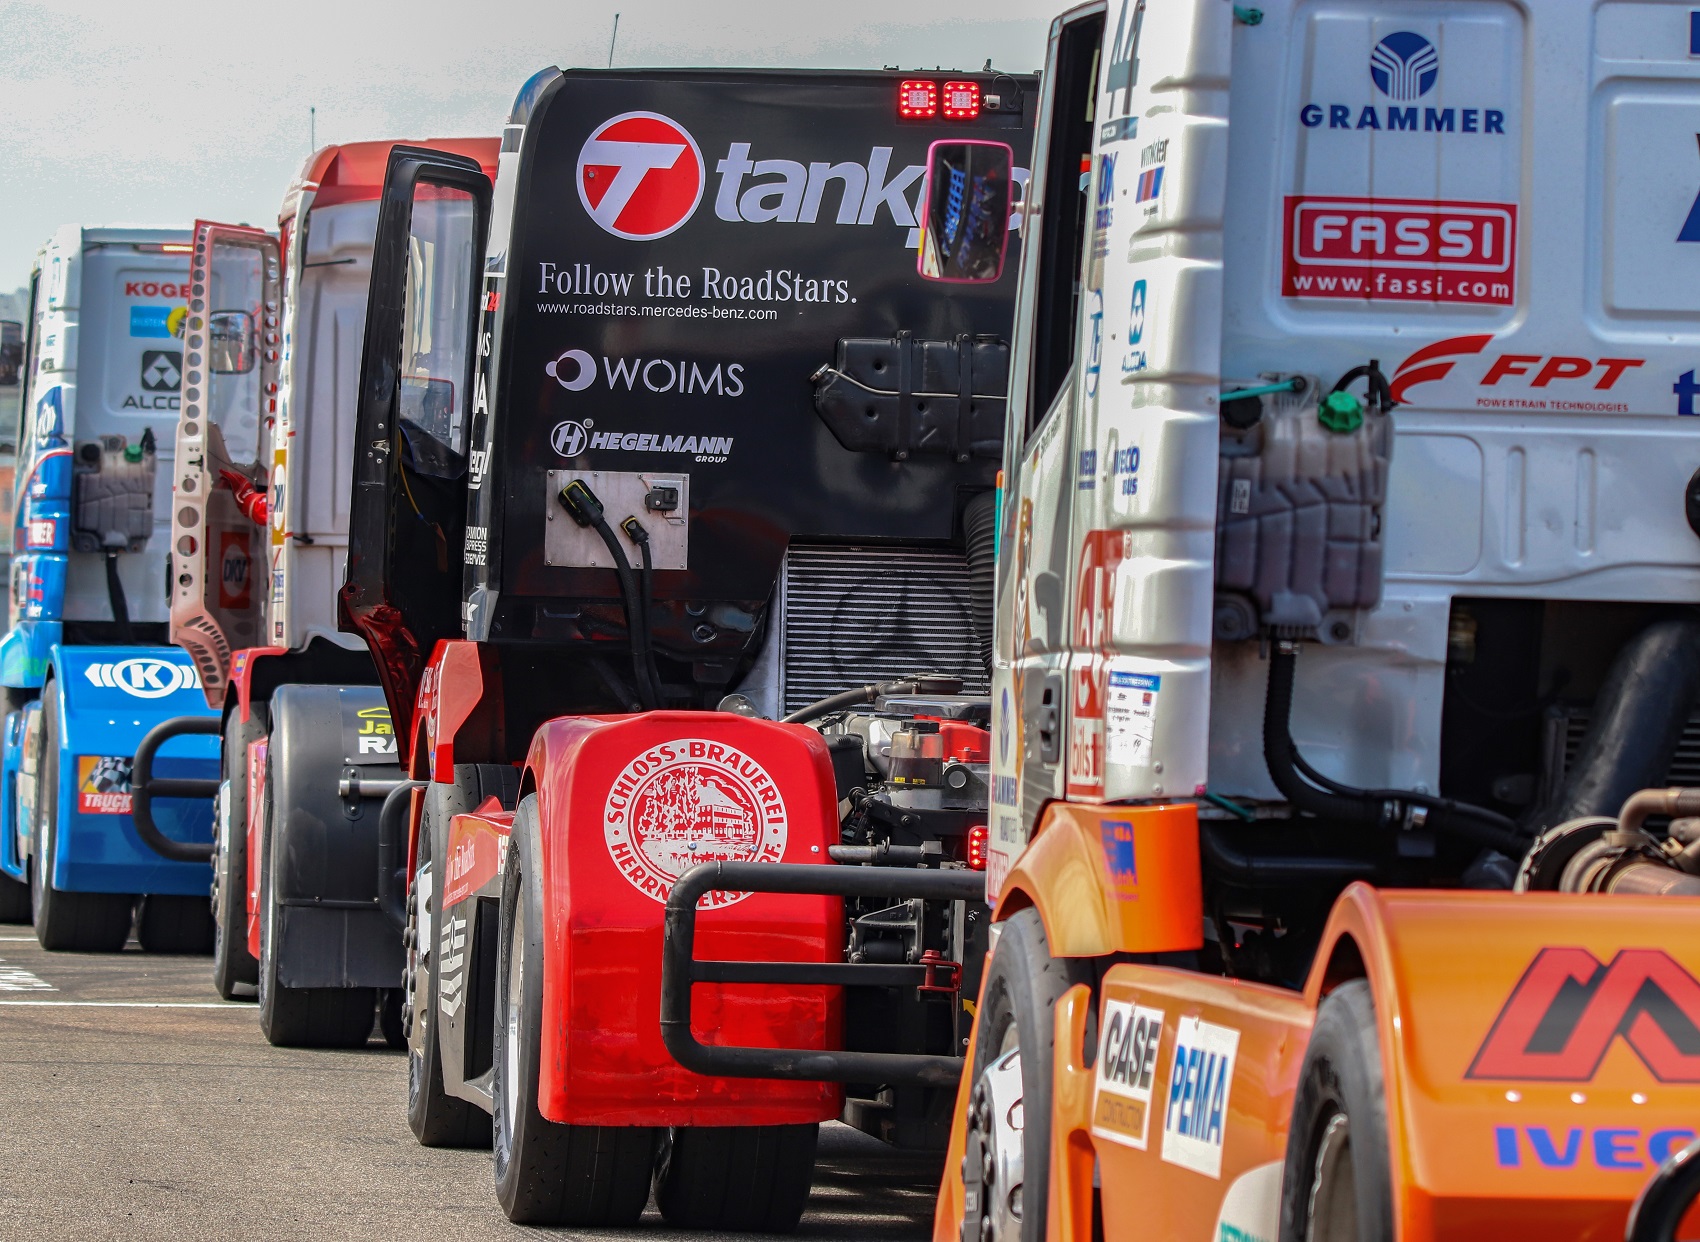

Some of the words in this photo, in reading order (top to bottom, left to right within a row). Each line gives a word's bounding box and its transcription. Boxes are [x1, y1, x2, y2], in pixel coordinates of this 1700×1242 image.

[1300, 104, 1505, 135] GRAMMER
[1313, 215, 1493, 259] FASSI
[538, 262, 634, 297] Follow
[644, 266, 691, 299] the
[701, 267, 857, 304] RoadStars.
[1293, 273, 1509, 299] www.fassi.com
[537, 302, 777, 320] www.roadstars.mercedes-benz.com
[603, 356, 744, 397] WOIMS
[1479, 354, 1646, 391] FPT
[1476, 397, 1547, 409] POWERTRAIN
[1550, 401, 1629, 413] TECHNOLOGIES
[589, 432, 734, 455] HEGELMANN
[695, 455, 727, 464] GROUP
[222, 558, 248, 583] DKV
[358, 720, 394, 734] Ja
[607, 744, 677, 824] SCHLOSS
[689, 741, 785, 825] BRAUEREI
[84, 793, 132, 809] TRUCK
[1103, 1010, 1161, 1091] CASE
[1166, 1044, 1229, 1147] PEMA
